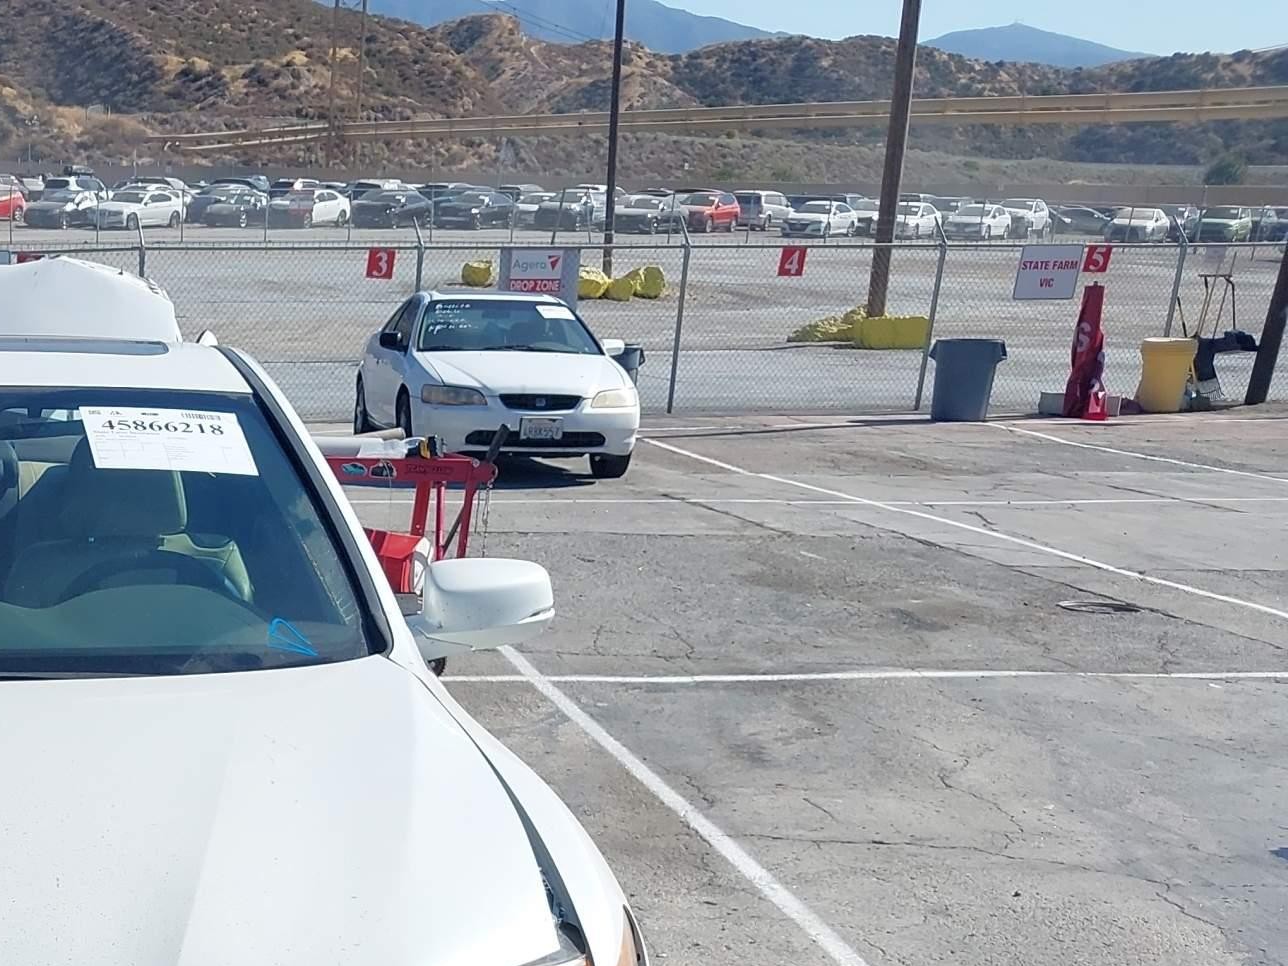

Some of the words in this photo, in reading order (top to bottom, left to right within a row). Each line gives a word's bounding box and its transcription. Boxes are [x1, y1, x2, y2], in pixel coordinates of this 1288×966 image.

[372, 251, 388, 276] 3
[783, 249, 800, 274] 4
[1021, 260, 1049, 271] STATE
[1052, 260, 1078, 271] FARM
[1088, 246, 1106, 270] 5
[510, 279, 535, 291] DROP
[535, 279, 560, 291] ZONE
[1039, 277, 1054, 288] VIC
[101, 418, 224, 436] 45866218
